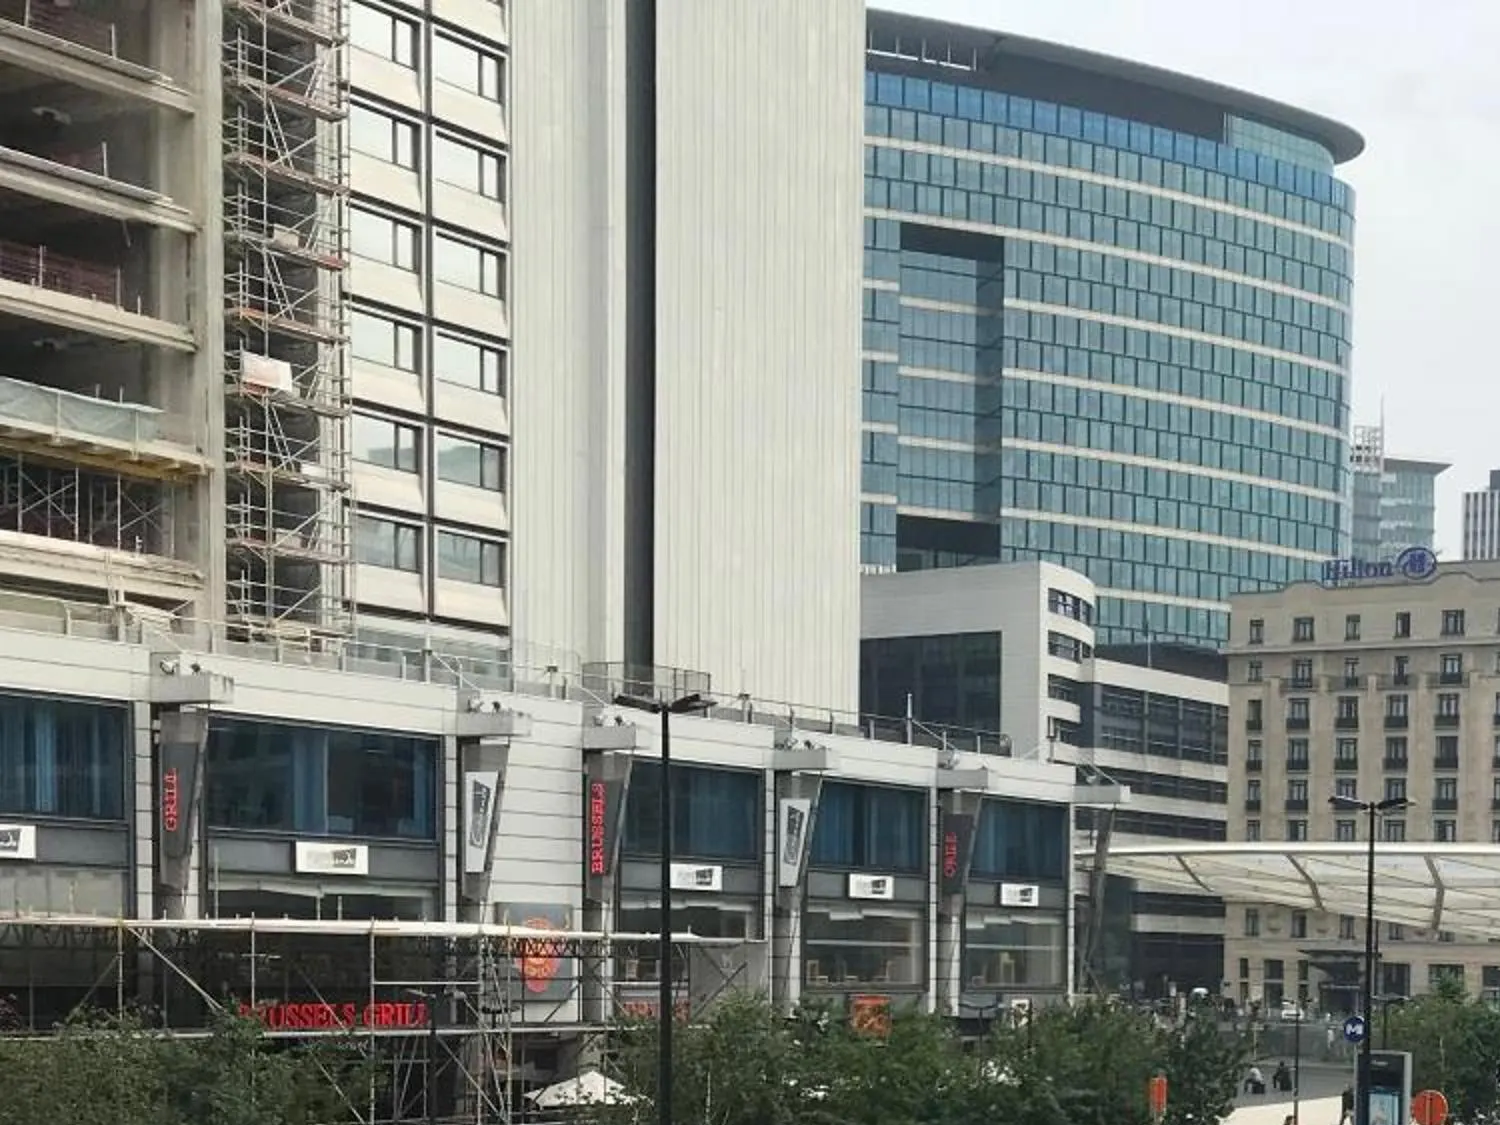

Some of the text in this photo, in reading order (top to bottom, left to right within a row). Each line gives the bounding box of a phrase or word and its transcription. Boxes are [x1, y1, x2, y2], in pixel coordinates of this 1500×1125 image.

[1324, 557, 1394, 580] Hilton
[591, 782, 606, 875] BRUSSELS
[363, 1001, 429, 1026] GRILL
[1345, 1023, 1364, 1036] M
